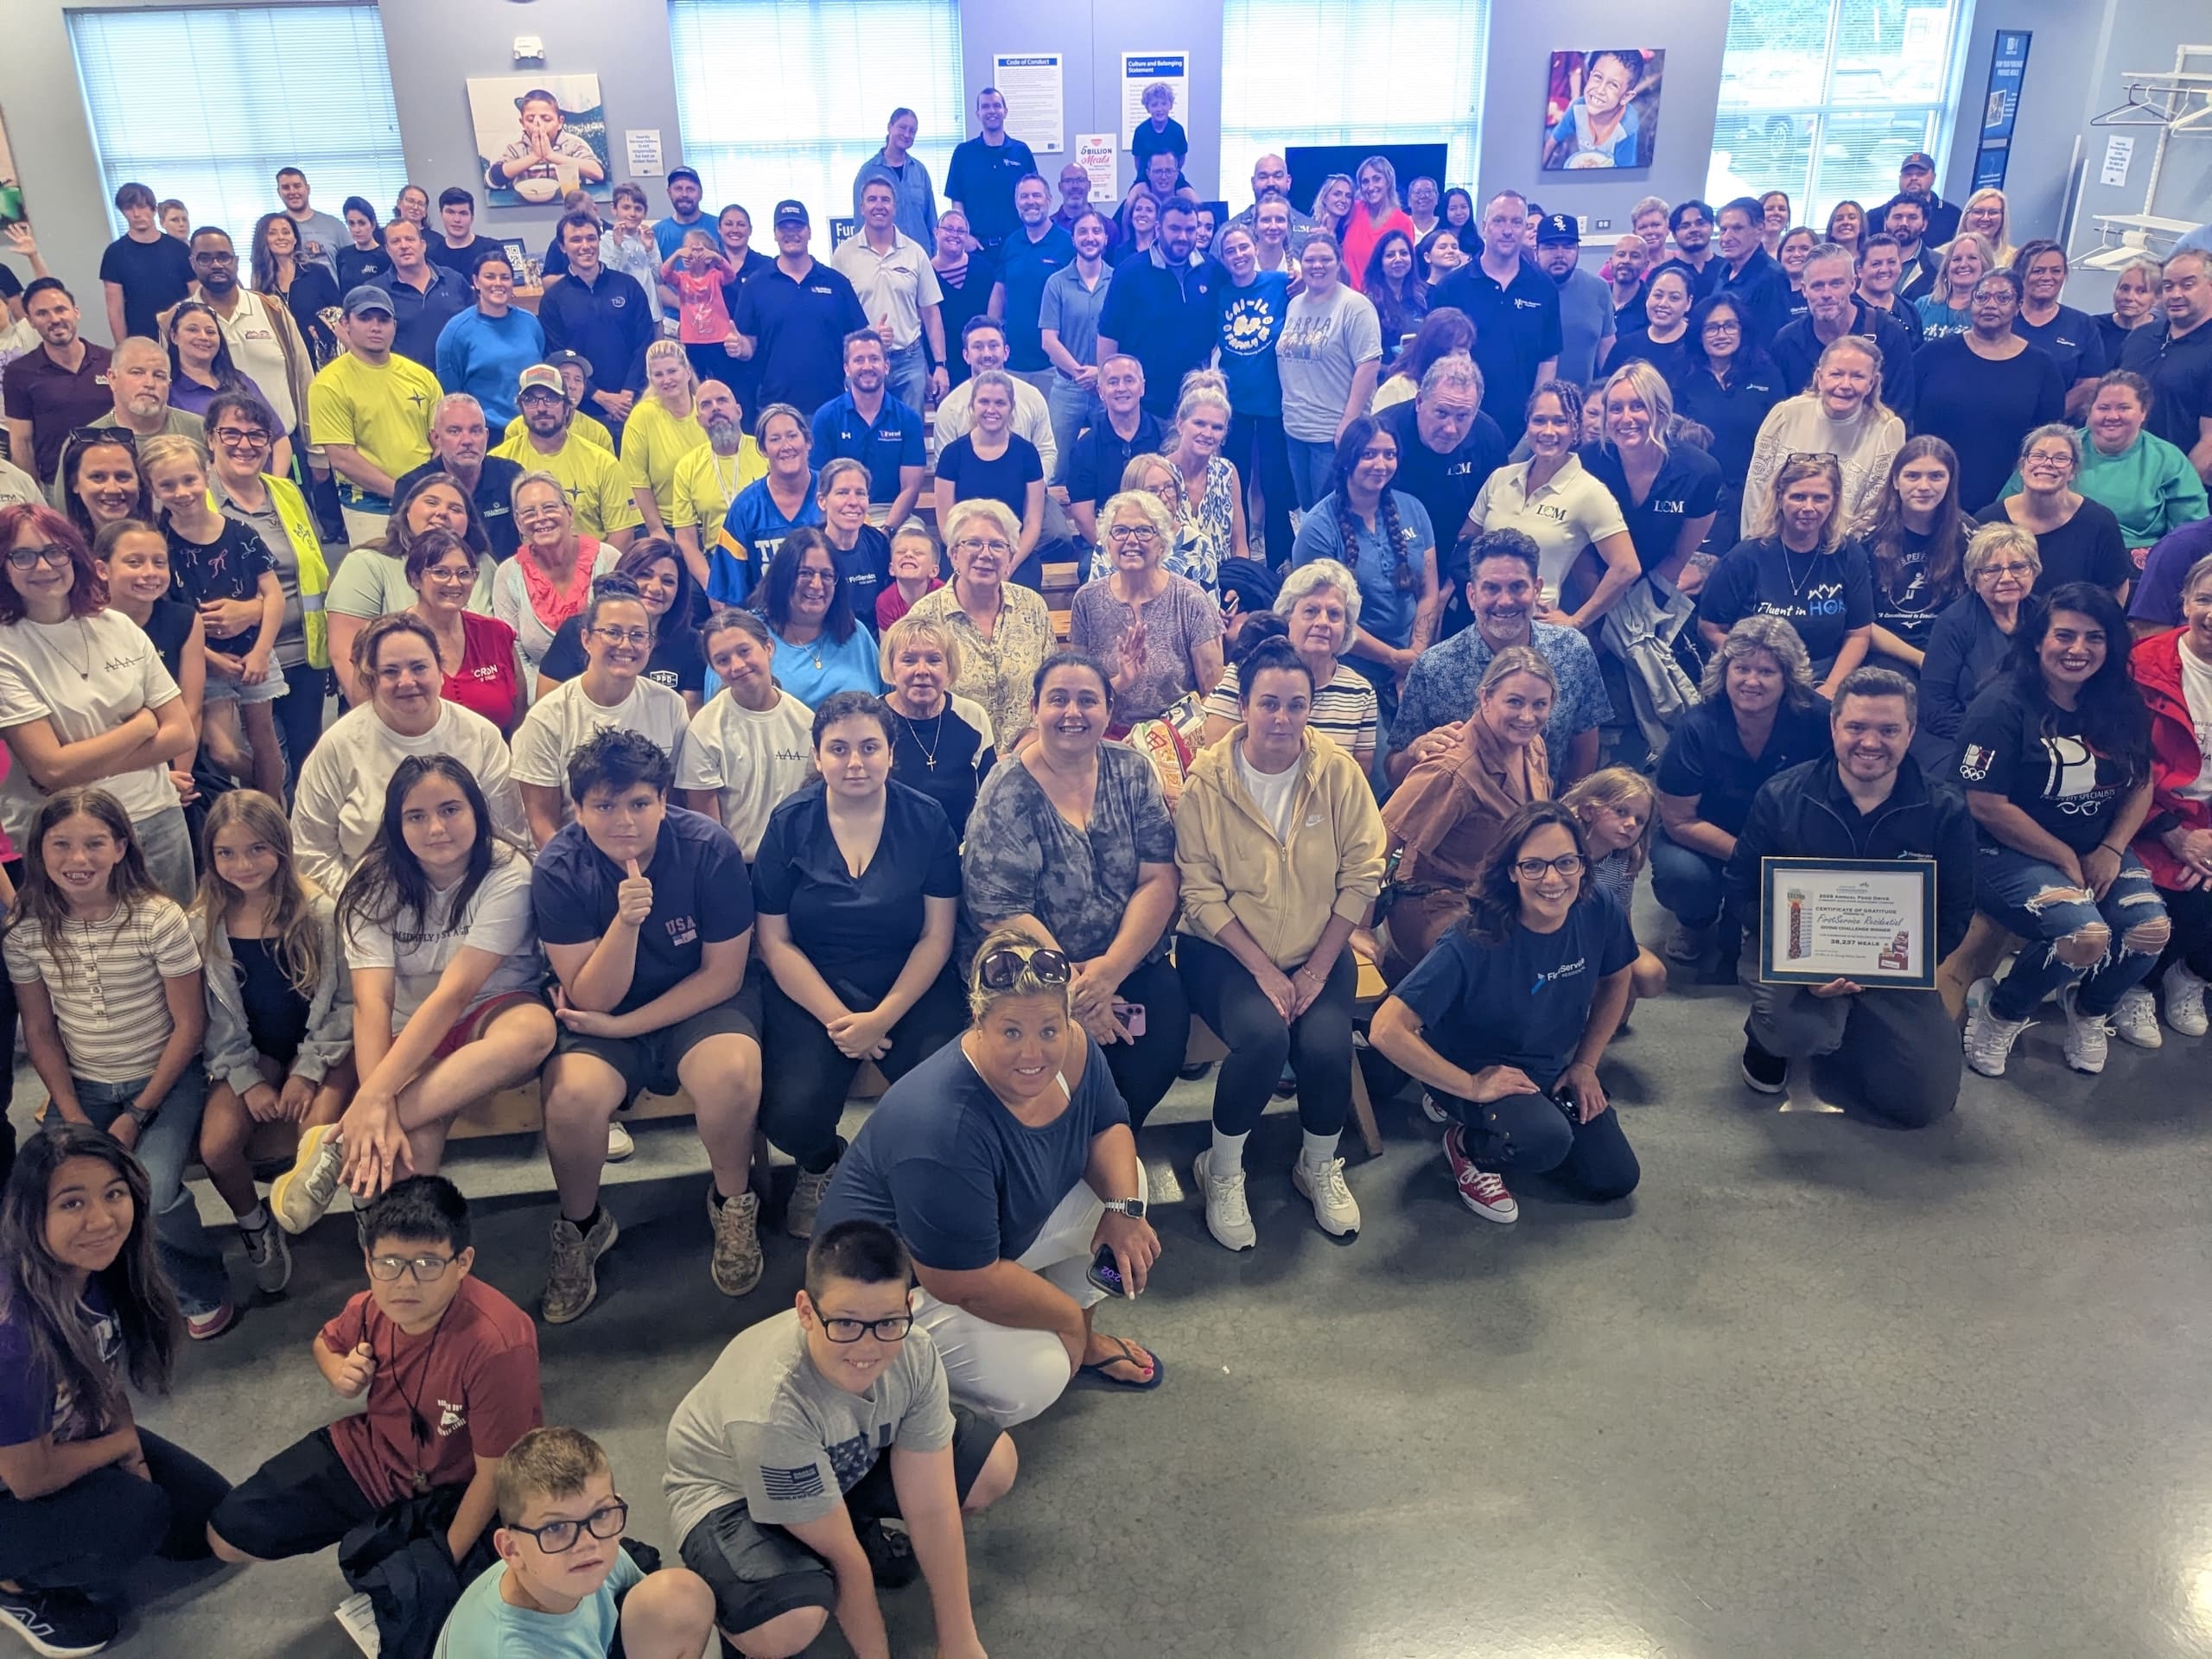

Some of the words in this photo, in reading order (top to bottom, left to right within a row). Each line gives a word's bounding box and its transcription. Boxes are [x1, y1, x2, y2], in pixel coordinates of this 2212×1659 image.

[1535, 505, 1567, 520] LCM
[1653, 500, 1685, 512] LCM
[1758, 602, 1794, 616] Fluent
[1796, 607, 1807, 616] in
[665, 916, 696, 936] USA
